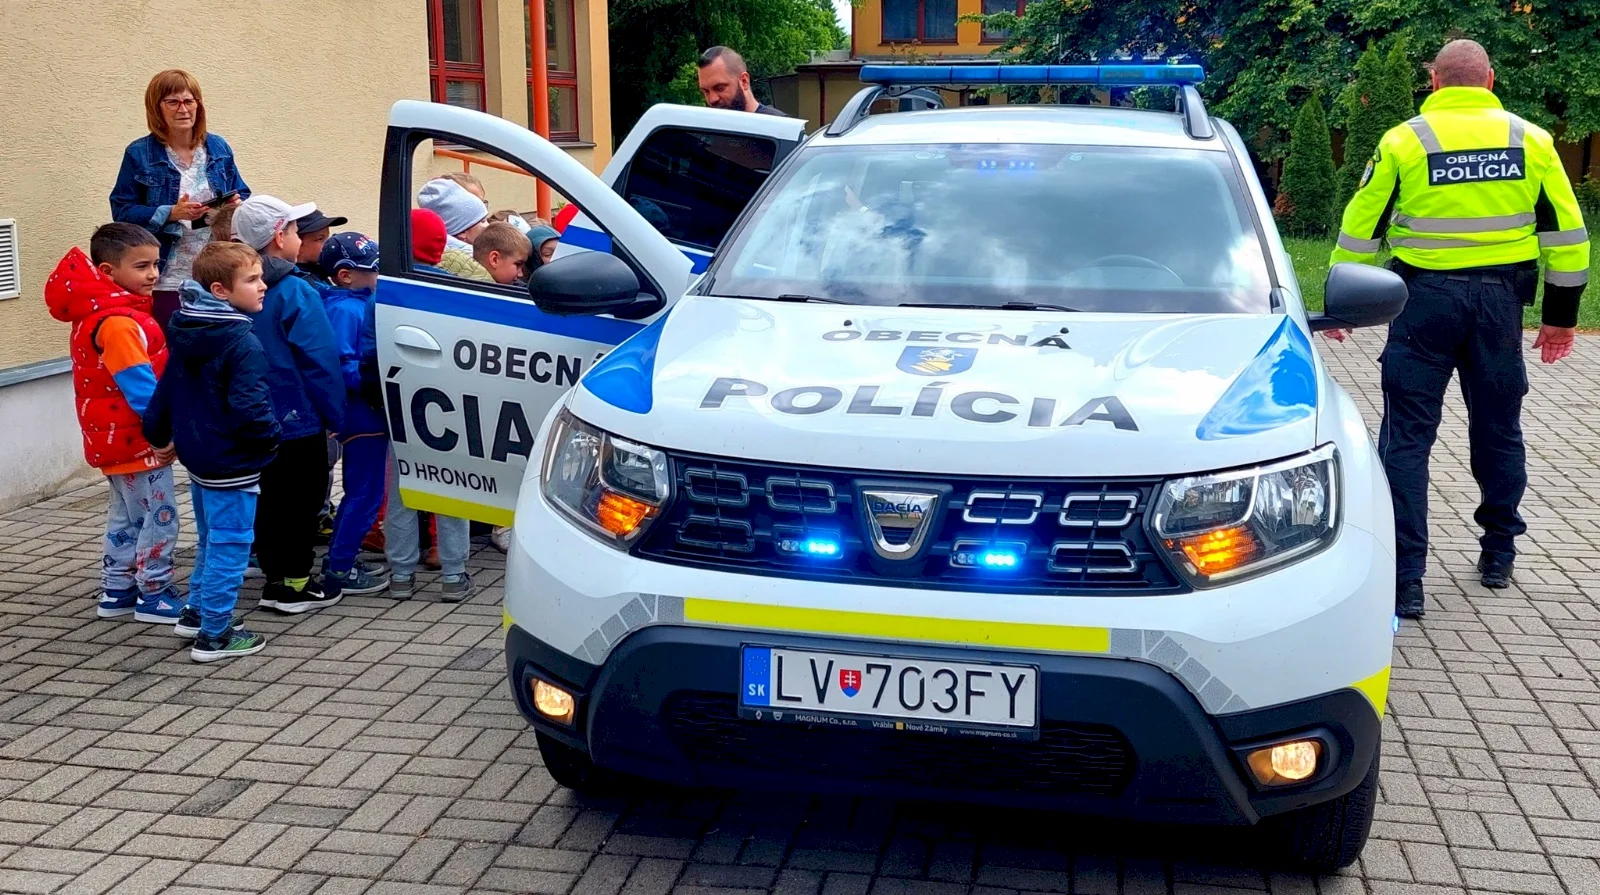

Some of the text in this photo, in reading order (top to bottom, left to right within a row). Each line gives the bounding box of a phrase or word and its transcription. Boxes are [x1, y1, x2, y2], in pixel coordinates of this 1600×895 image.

[1445, 151, 1509, 164] OBECNÁ
[1432, 162, 1522, 182] POLÍCIA
[822, 330, 1072, 350] OBECNÁ
[453, 339, 604, 387] OBECN
[385, 366, 535, 463] ÍCIA
[699, 377, 1140, 432] POLÍCIA
[415, 461, 498, 494] HRONOM
[872, 501, 923, 514] DACIA
[748, 683, 765, 697] SK
[795, 714, 828, 724] MAGNUM
[872, 720, 894, 729] Vráble
[905, 723, 924, 732] Nové
[924, 725, 948, 735] Zámky
